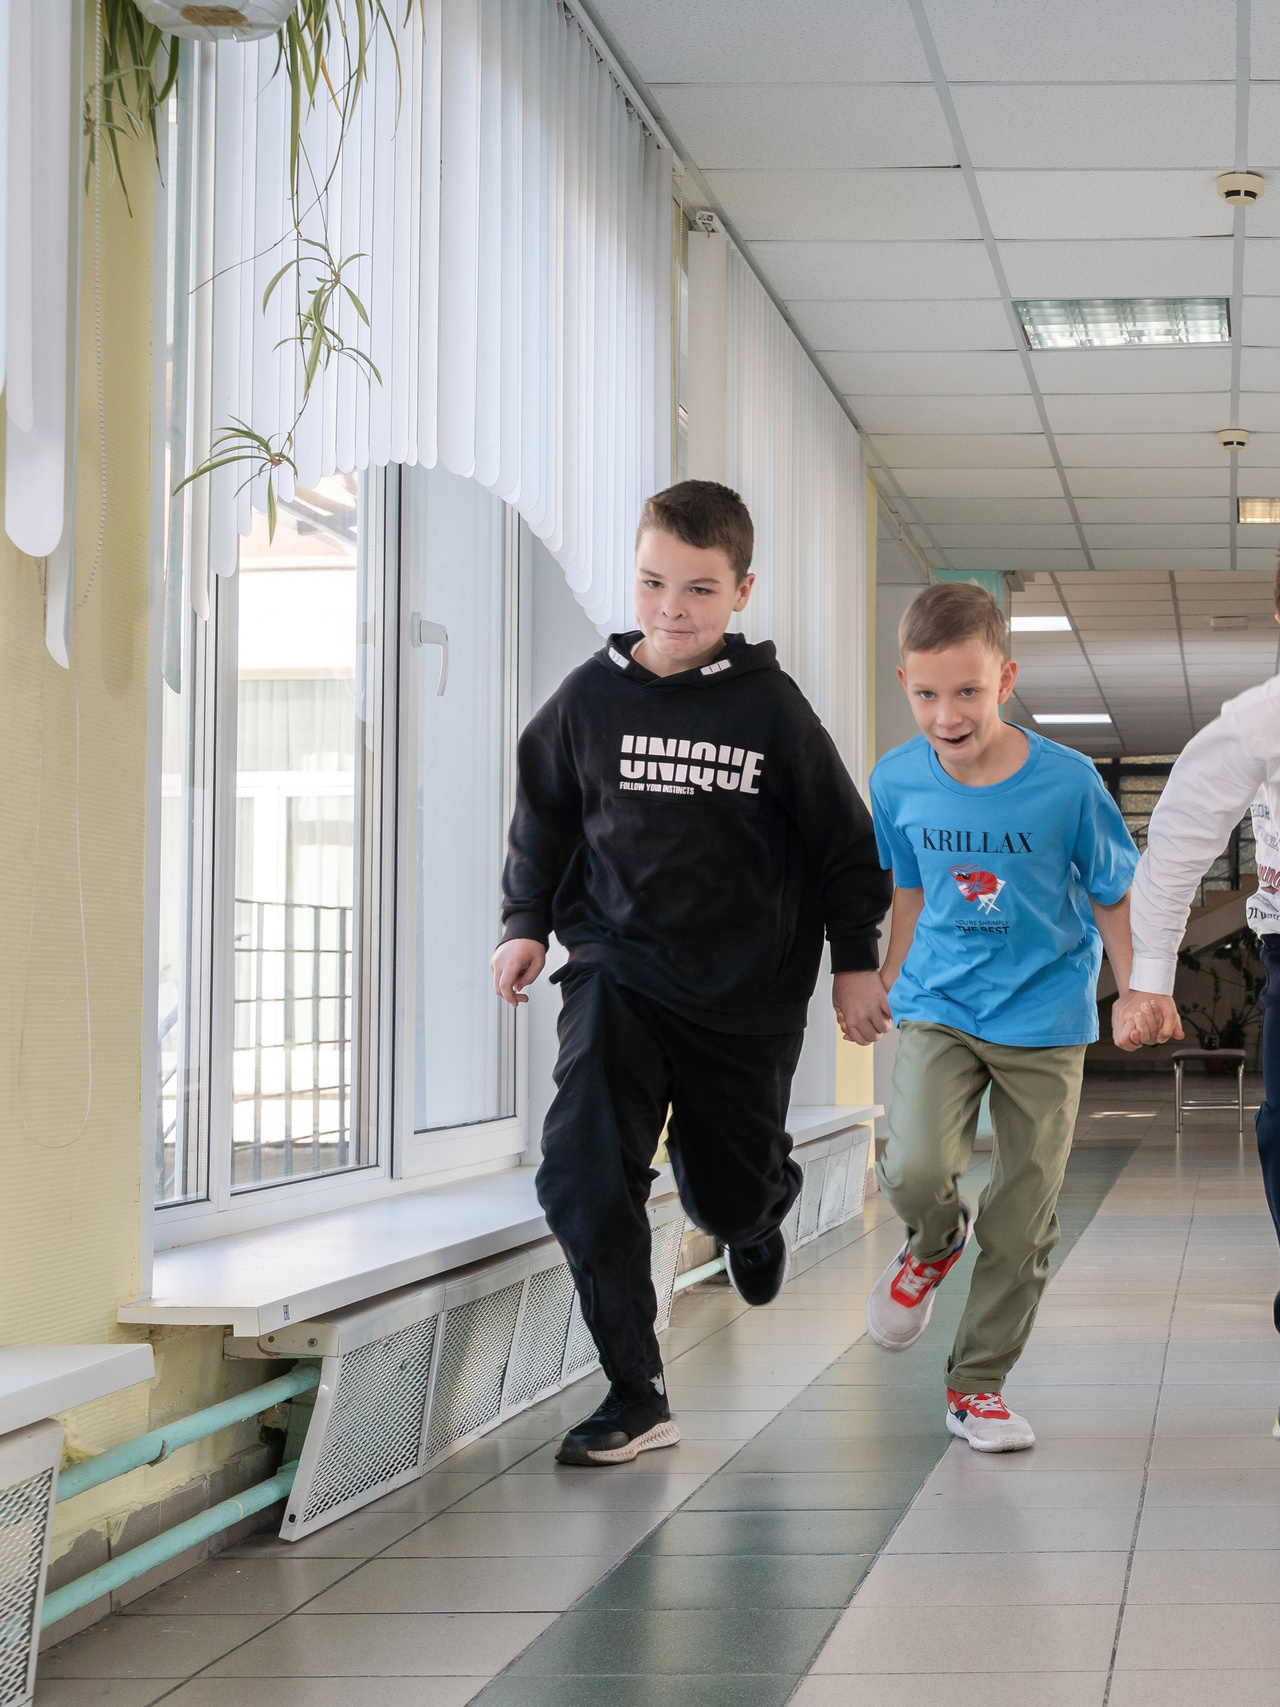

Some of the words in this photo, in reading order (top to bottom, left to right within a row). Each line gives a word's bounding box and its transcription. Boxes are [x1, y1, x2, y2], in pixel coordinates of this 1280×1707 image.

[619, 734, 765, 795] UNIQUE
[619, 781, 645, 791] FOLLOW
[646, 783, 662, 793] YOUR
[662, 784, 695, 796] INSTINCTS
[922, 827, 1034, 854] KRILLAX
